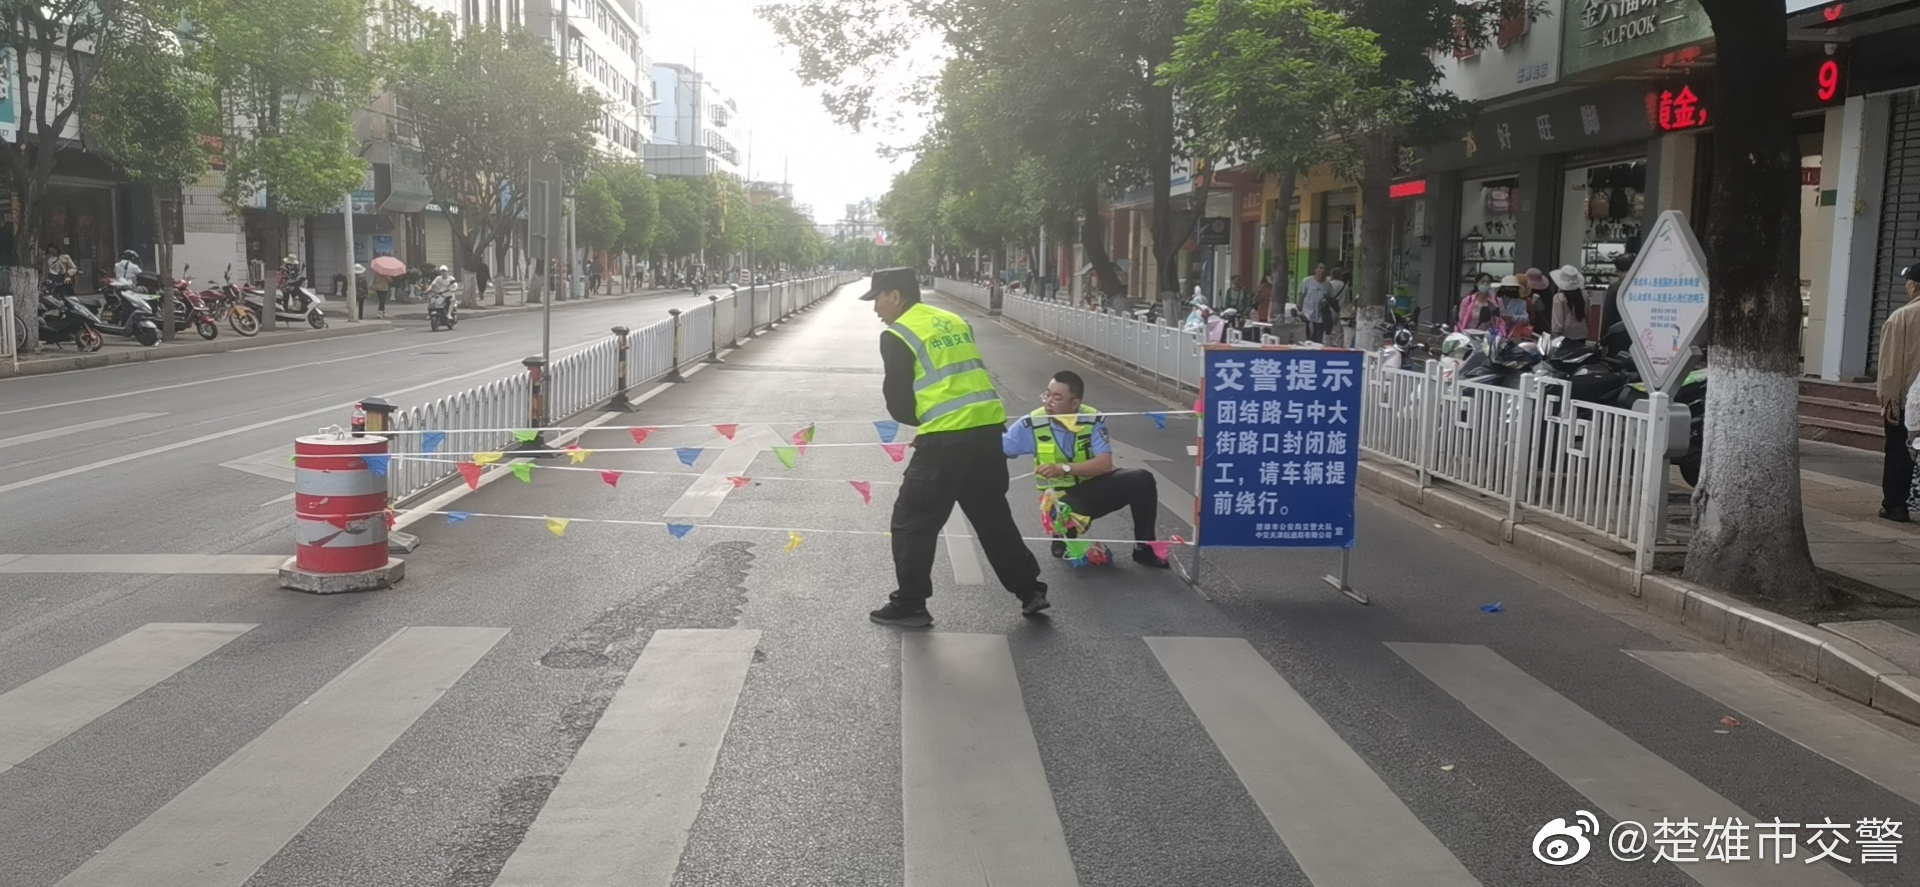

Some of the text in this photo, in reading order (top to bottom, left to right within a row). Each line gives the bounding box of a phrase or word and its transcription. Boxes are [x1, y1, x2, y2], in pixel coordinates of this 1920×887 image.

[1602, 15, 1656, 47] KLFOOK
[1818, 60, 1838, 100] 9
[1214, 358, 1353, 392] 交警提示
[1217, 400, 1348, 424] 团结路与中大
[1216, 430, 1347, 455] 街路口封闭施
[1214, 461, 1346, 486] 工，请车辆提
[1214, 491, 1289, 515] 前绕行。
